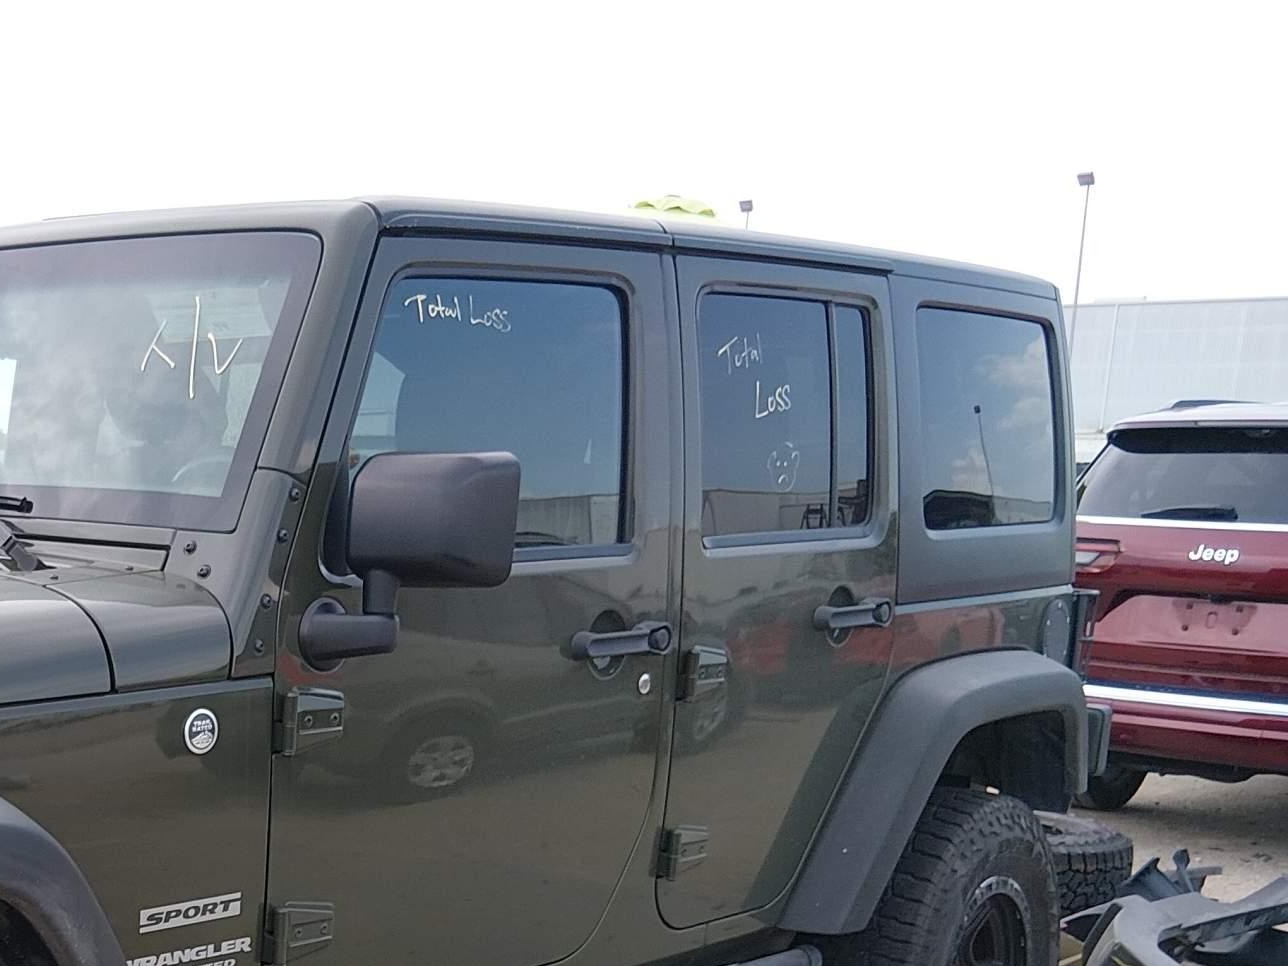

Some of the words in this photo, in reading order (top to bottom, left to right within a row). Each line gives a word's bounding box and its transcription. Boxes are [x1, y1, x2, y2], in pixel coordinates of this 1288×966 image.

[404, 293, 461, 323] Total
[469, 294, 511, 332] Loss
[717, 331, 763, 375] Total
[755, 379, 792, 418] Loss
[1188, 543, 1240, 566] Jeep
[142, 899, 238, 927] SPORT
